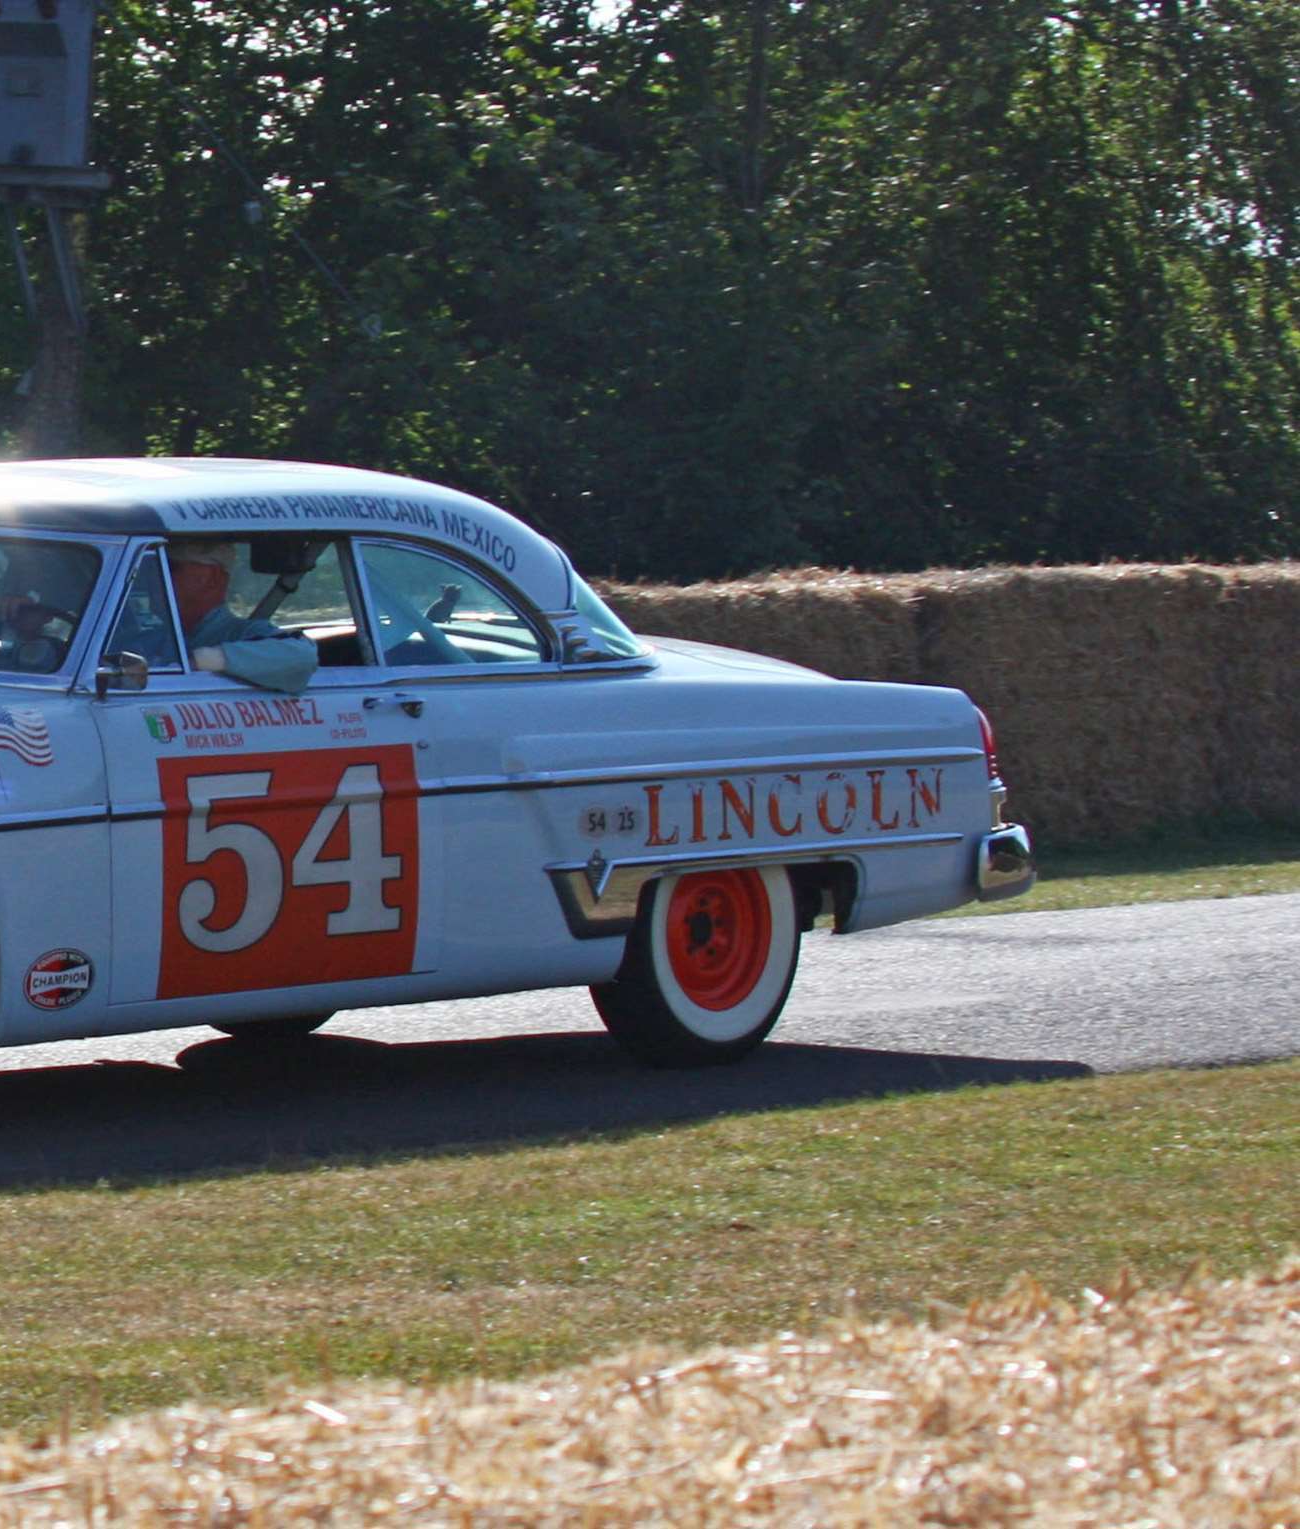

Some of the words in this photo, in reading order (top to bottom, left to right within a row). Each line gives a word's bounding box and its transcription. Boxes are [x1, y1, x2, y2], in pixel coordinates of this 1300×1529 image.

[172, 500, 187, 520] V
[188, 498, 286, 520] CARRERA
[284, 495, 438, 529] PANAMERICANA
[441, 509, 516, 572] MEXICO
[174, 703, 236, 730] JULIO
[236, 698, 323, 727] BALMEZ
[588, 811, 606, 832] 54
[643, 768, 943, 847] LINCOLN
[178, 763, 402, 953] 54
[33, 971, 87, 988] CHAMPION
